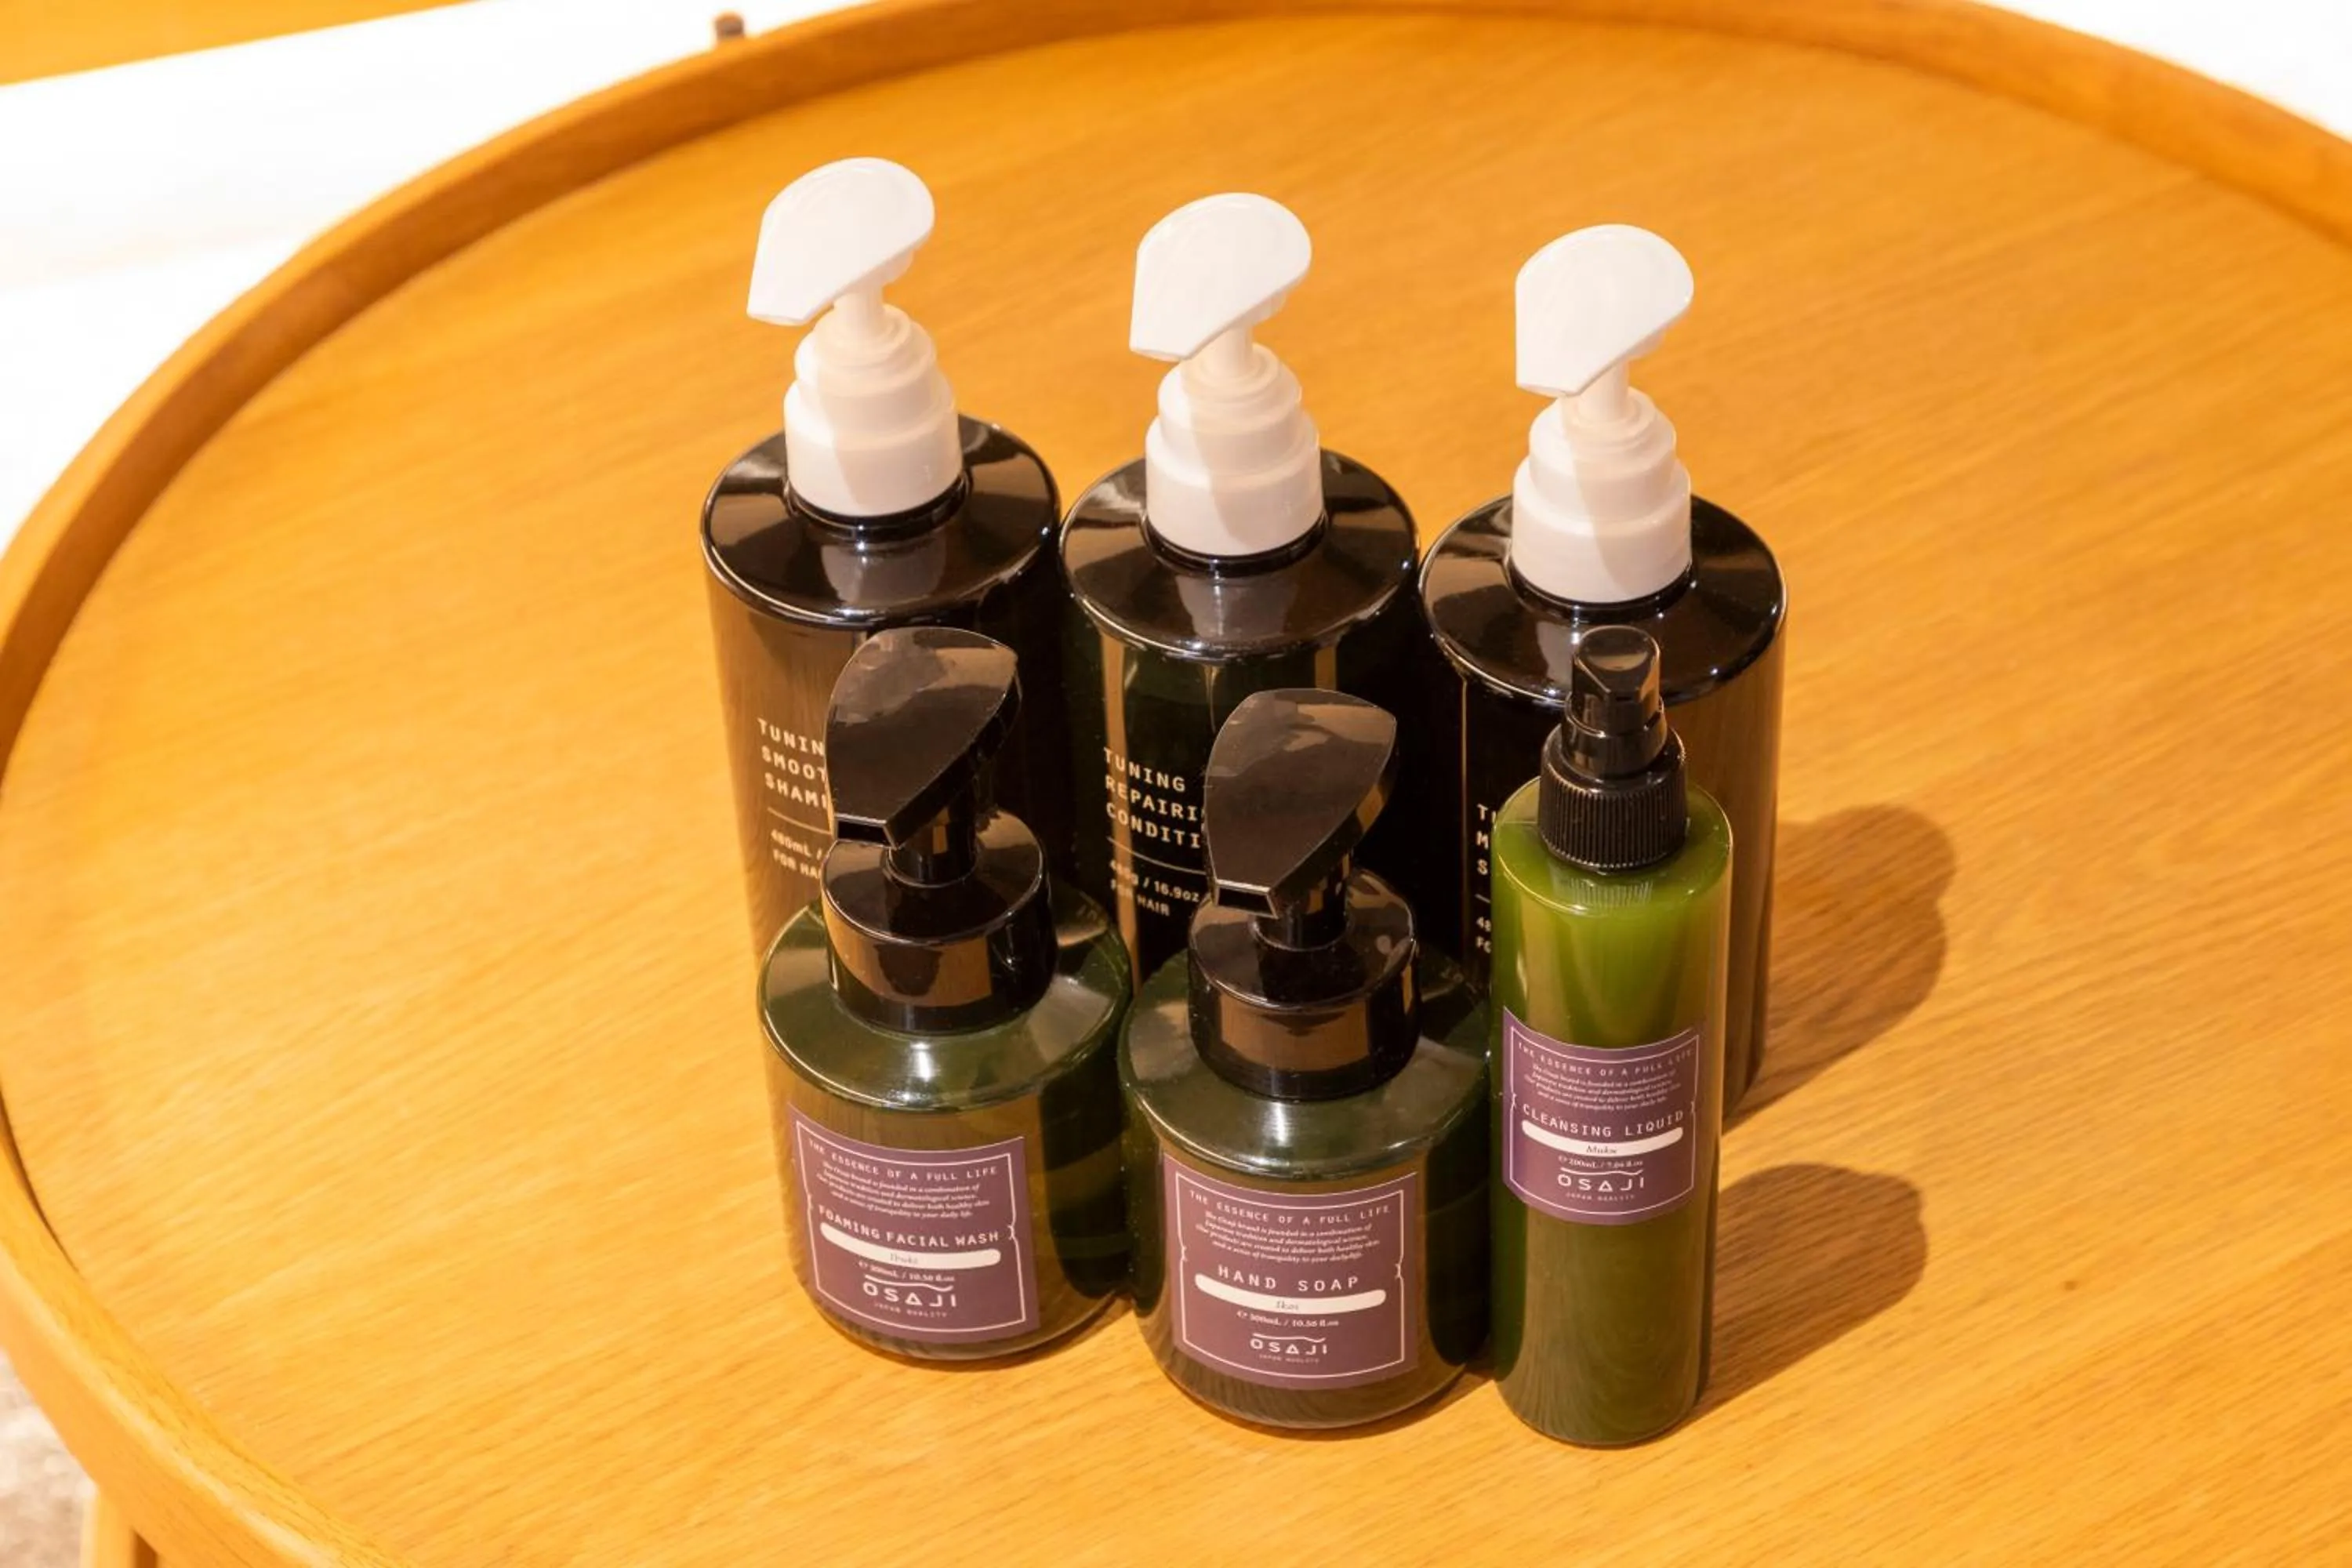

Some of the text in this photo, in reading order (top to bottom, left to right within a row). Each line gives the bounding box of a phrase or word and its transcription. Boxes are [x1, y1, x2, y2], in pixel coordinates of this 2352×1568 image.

[1104, 746, 1185, 792] TUNING
[1105, 775, 1205, 822] REPAIRI
[1106, 802, 1200, 849] CONDITI
[1136, 895, 1171, 916] HAIR
[1523, 1103, 1683, 1137] CLEANSING LIQUID
[1558, 1174, 1645, 1192] OSAJI
[818, 1204, 999, 1247] FOAMING FACIAL WASH
[1302, 1216, 1310, 1225] A
[1218, 1264, 1359, 1292] HAND SOAP
[863, 1281, 956, 1307] OSAJI
[1250, 1338, 1327, 1355] OSAJI
